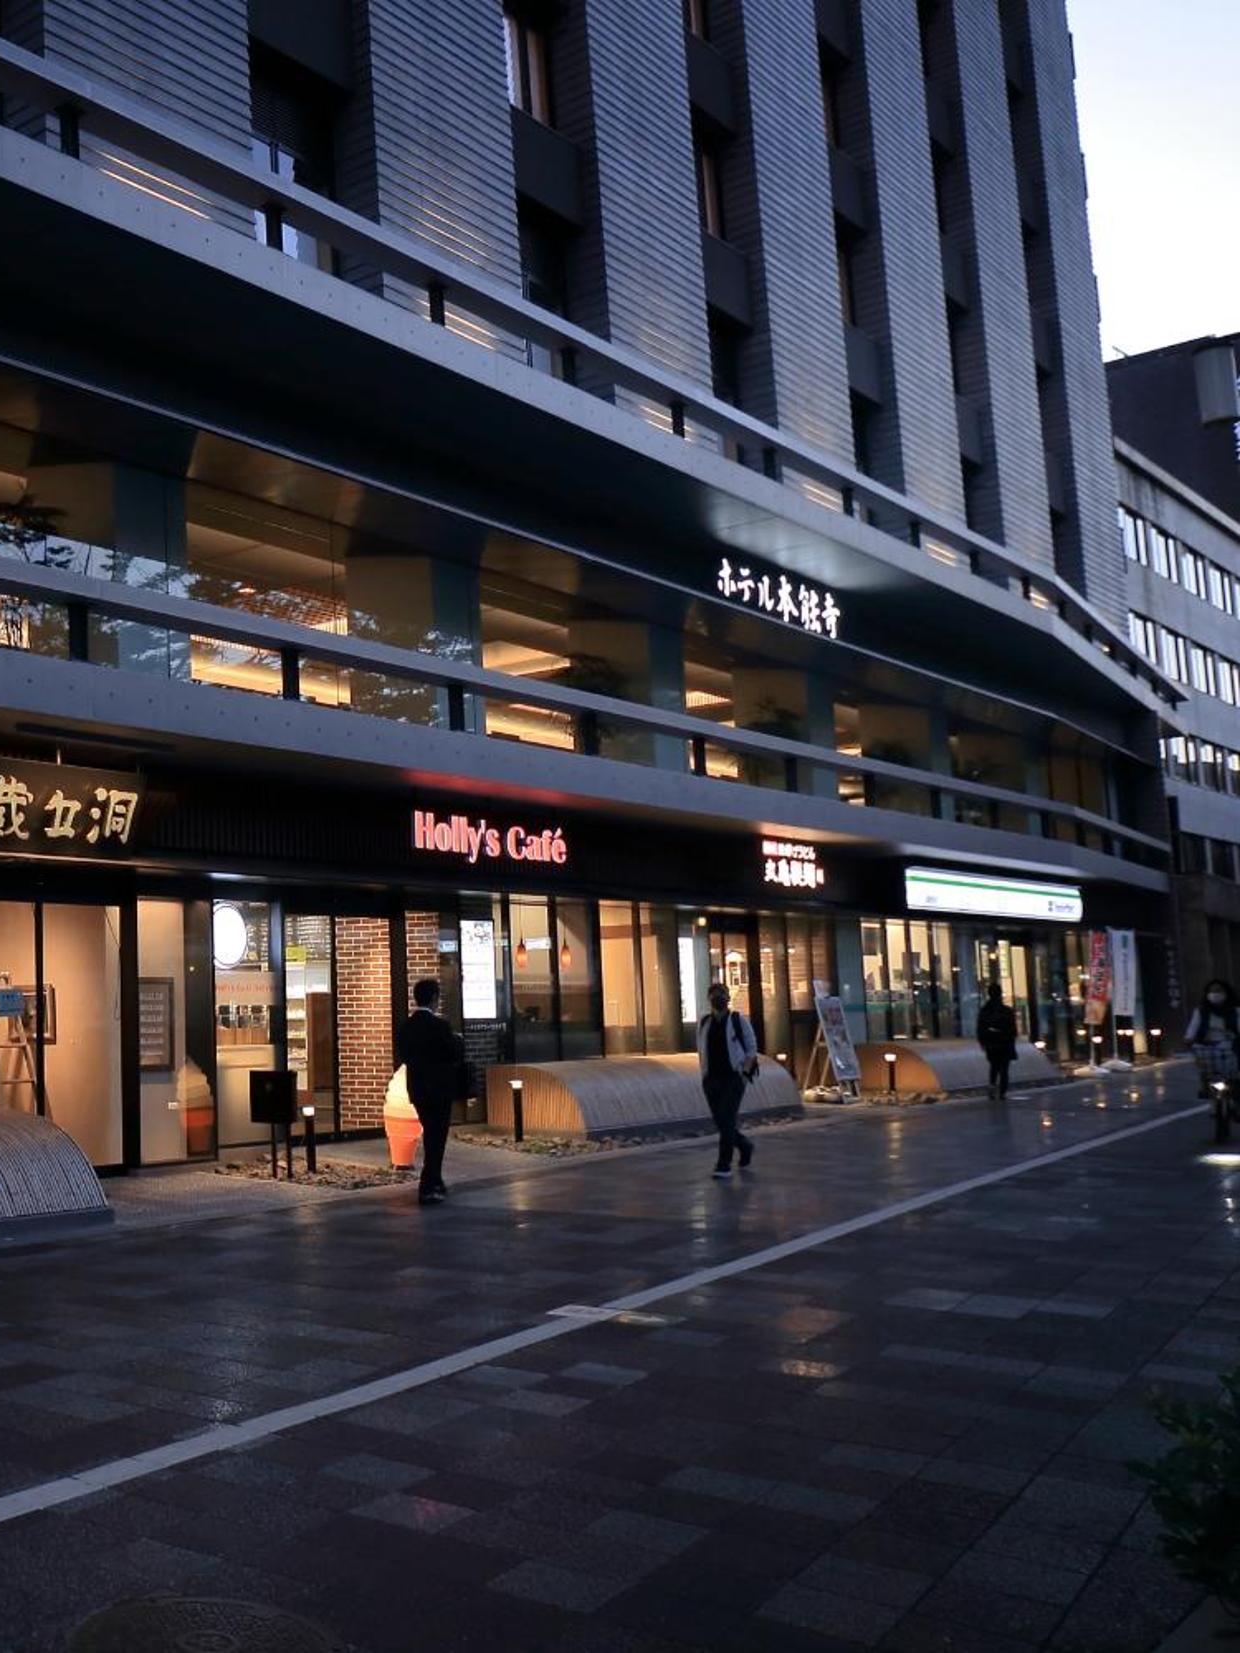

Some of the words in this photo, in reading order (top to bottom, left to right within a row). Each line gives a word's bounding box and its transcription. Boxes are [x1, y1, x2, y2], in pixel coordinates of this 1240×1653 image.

[717, 557, 841, 640] ホテル本能寺
[414, 810, 501, 864] Holly's
[506, 826, 567, 864] Café
